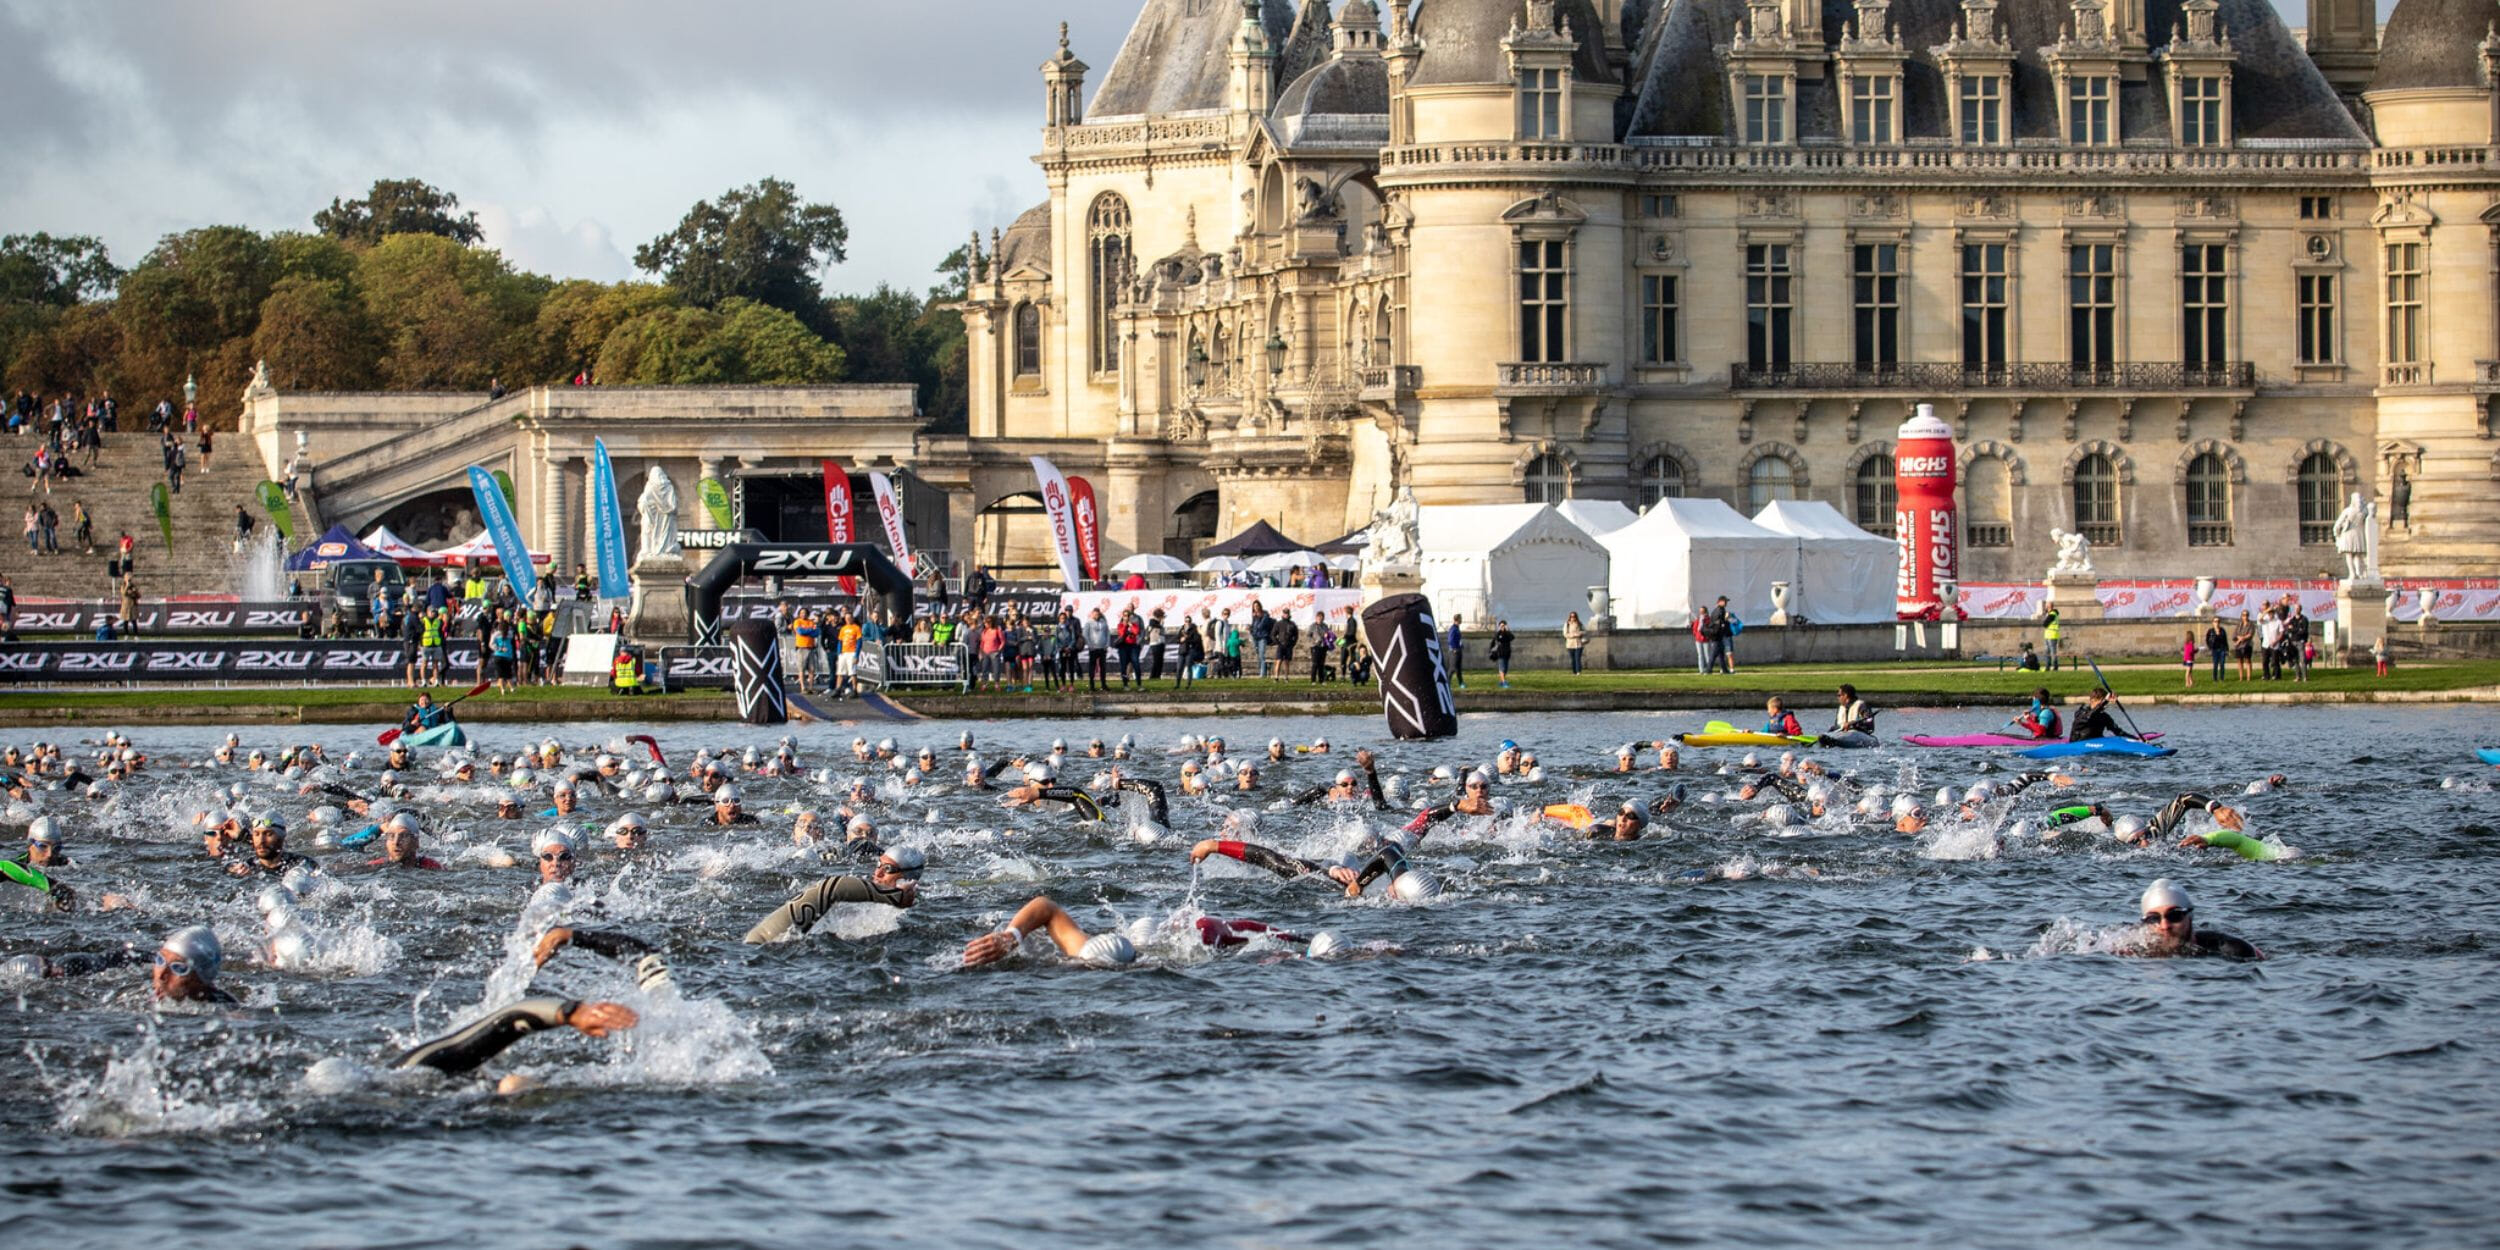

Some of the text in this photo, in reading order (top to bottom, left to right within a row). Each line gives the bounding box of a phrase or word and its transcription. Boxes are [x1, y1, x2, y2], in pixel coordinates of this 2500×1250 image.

[1900, 457, 1947, 471] HIGH5
[676, 531, 740, 547] FINISH
[754, 551, 852, 570] 2XU
[1031, 602, 1056, 615] 2XU
[2312, 601, 2337, 617] HIGH
[14, 613, 81, 627] 2XU
[167, 612, 235, 626] 2XU
[0, 652, 49, 668] XU
[58, 652, 137, 669] 2XU
[147, 652, 225, 668] 2XU
[235, 651, 313, 667] 2XU
[323, 651, 400, 667] 2XU
[1420, 613, 1456, 717] 2XU
